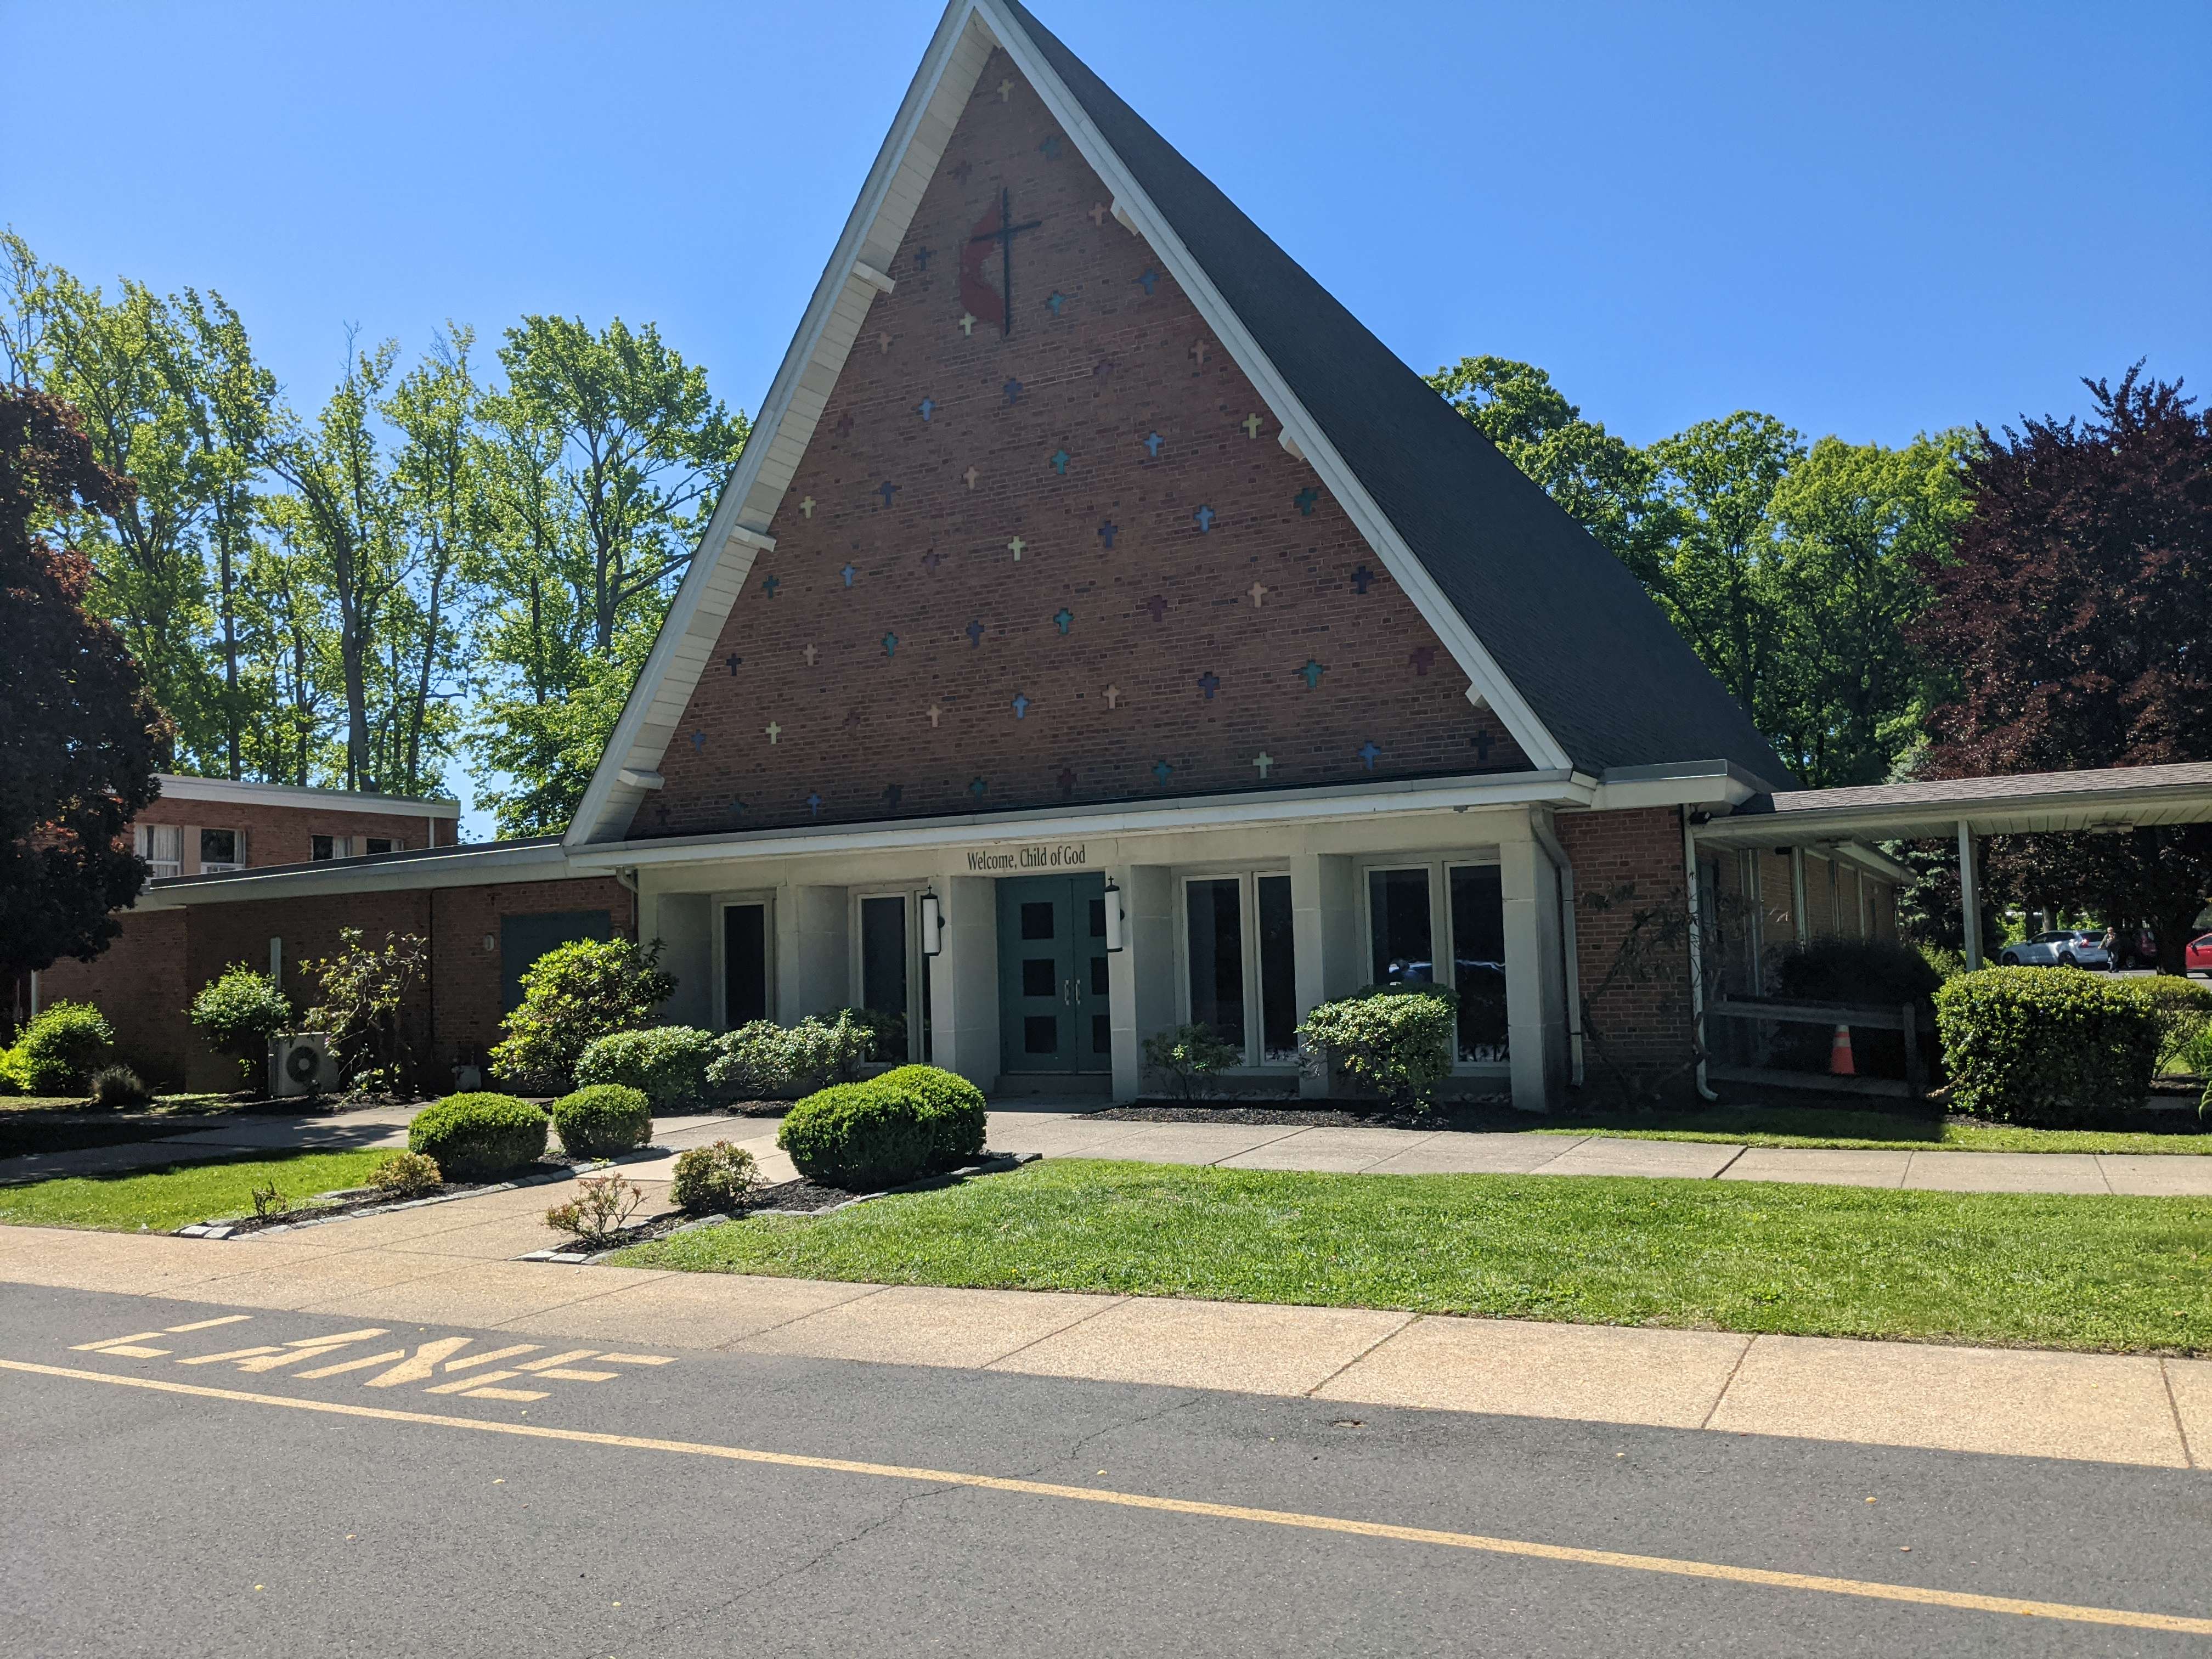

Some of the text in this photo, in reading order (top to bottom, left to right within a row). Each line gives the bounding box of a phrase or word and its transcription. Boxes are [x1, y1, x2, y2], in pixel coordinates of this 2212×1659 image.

[967, 844, 1086, 870] Welcome, Child of God
[67, 1315, 680, 1402] LANE
